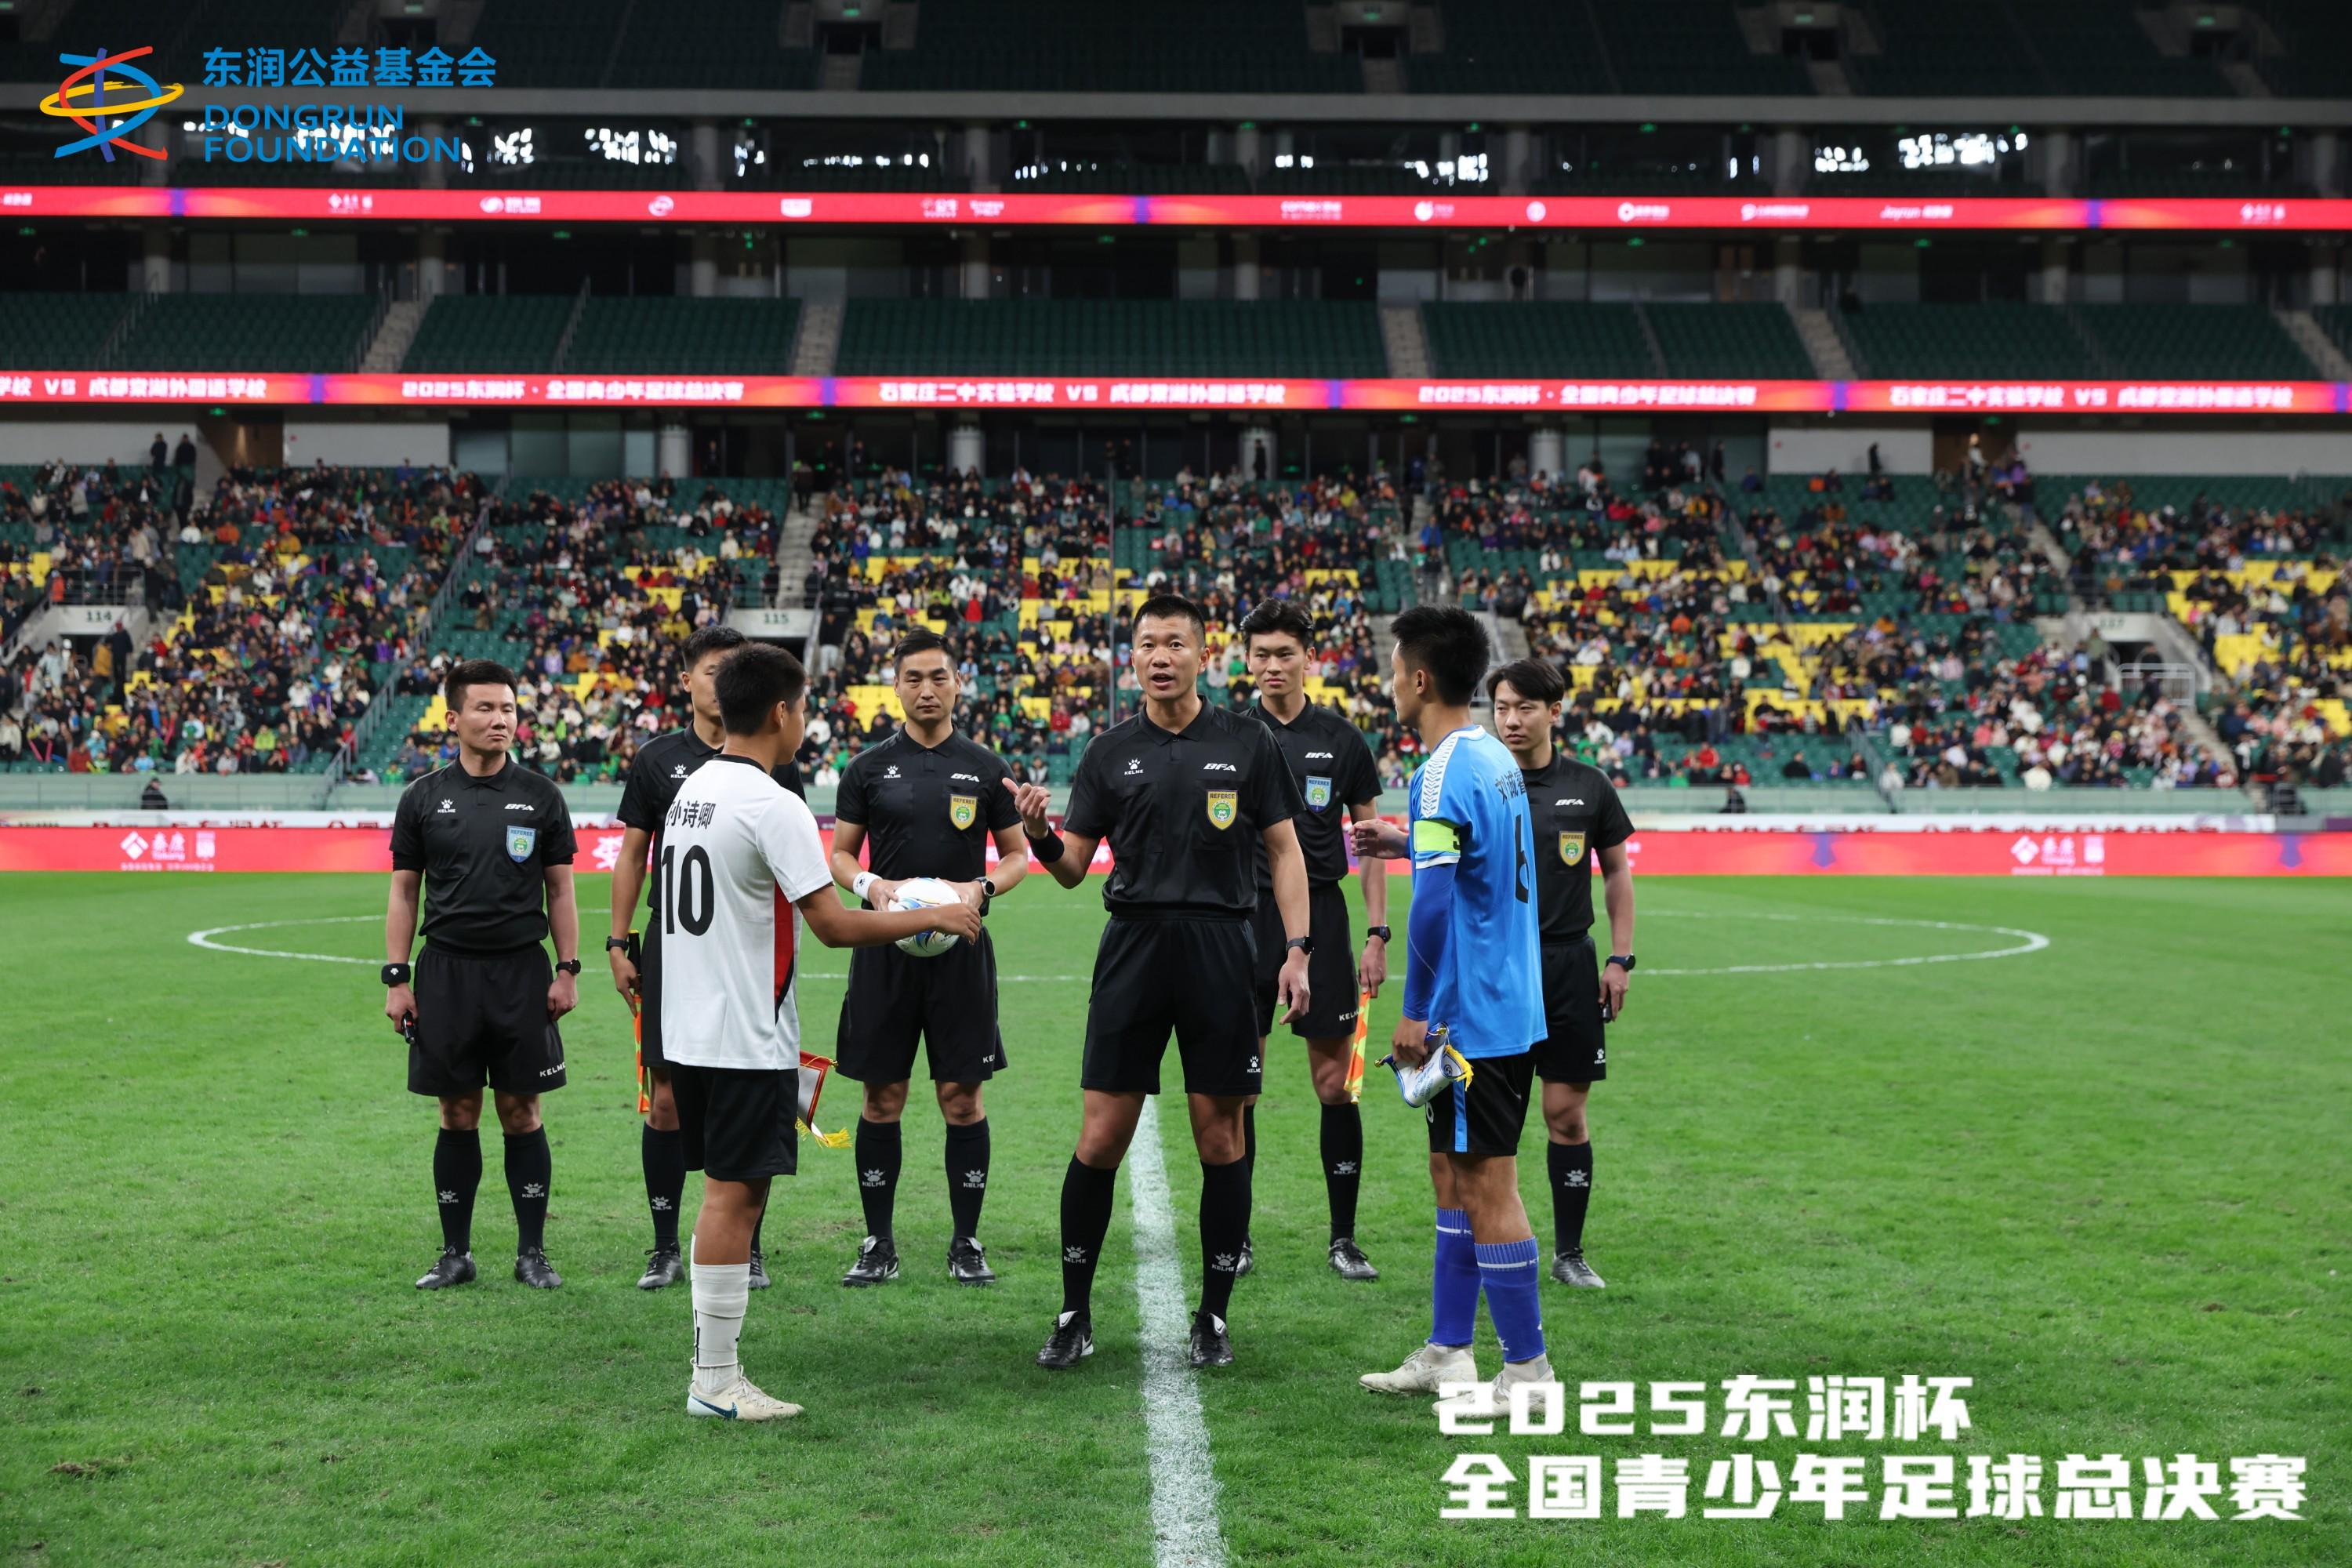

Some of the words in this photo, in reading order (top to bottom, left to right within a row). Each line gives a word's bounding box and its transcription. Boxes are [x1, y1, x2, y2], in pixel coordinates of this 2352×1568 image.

[44, 379, 76, 396] VS
[1065, 385, 1098, 401] VS
[2074, 388, 2107, 406] VS
[87, 610, 112, 622] 114
[764, 613, 789, 624] 115
[1203, 763, 1236, 772] BFA
[950, 773, 980, 782] BFA
[504, 803, 535, 811] BFA
[662, 844, 714, 936] 10
[539, 1061, 566, 1078] KELME
